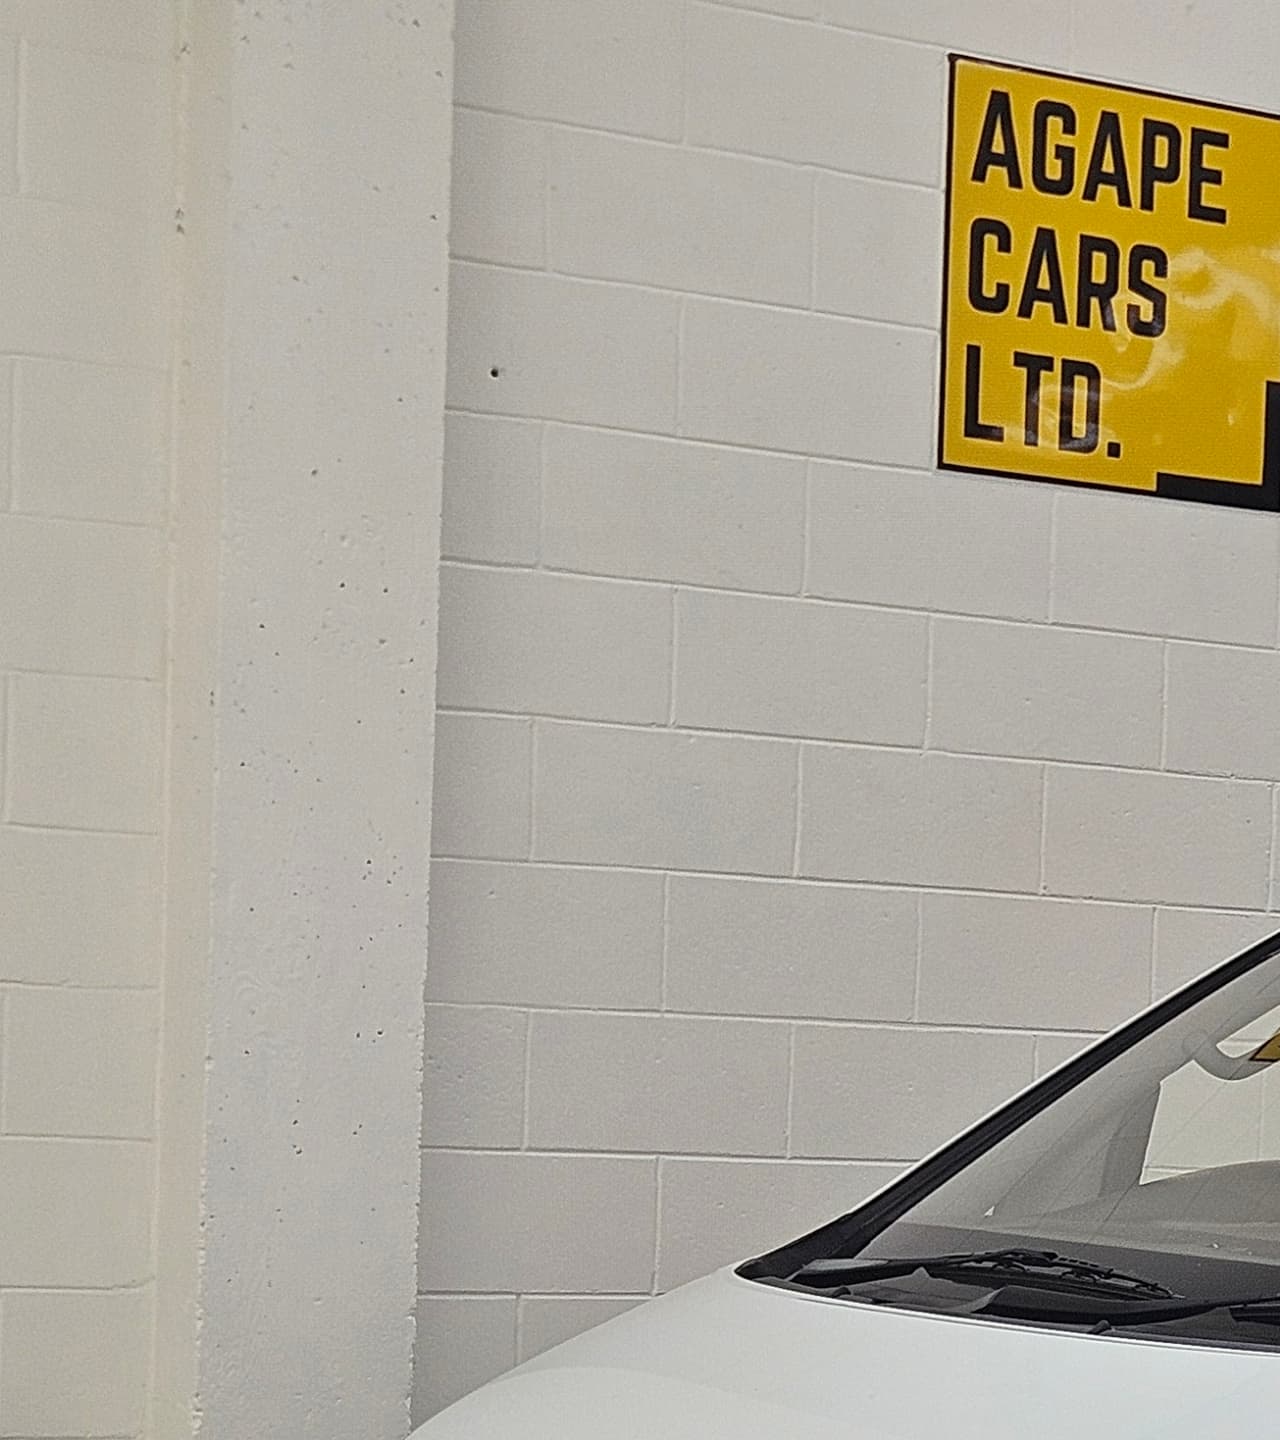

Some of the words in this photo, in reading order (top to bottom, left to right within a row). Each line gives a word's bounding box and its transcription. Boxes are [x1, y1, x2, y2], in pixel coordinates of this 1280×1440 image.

[970, 88, 1230, 225] AGAPE
[967, 216, 1168, 338] CARS
[963, 343, 1122, 459] LTD.
